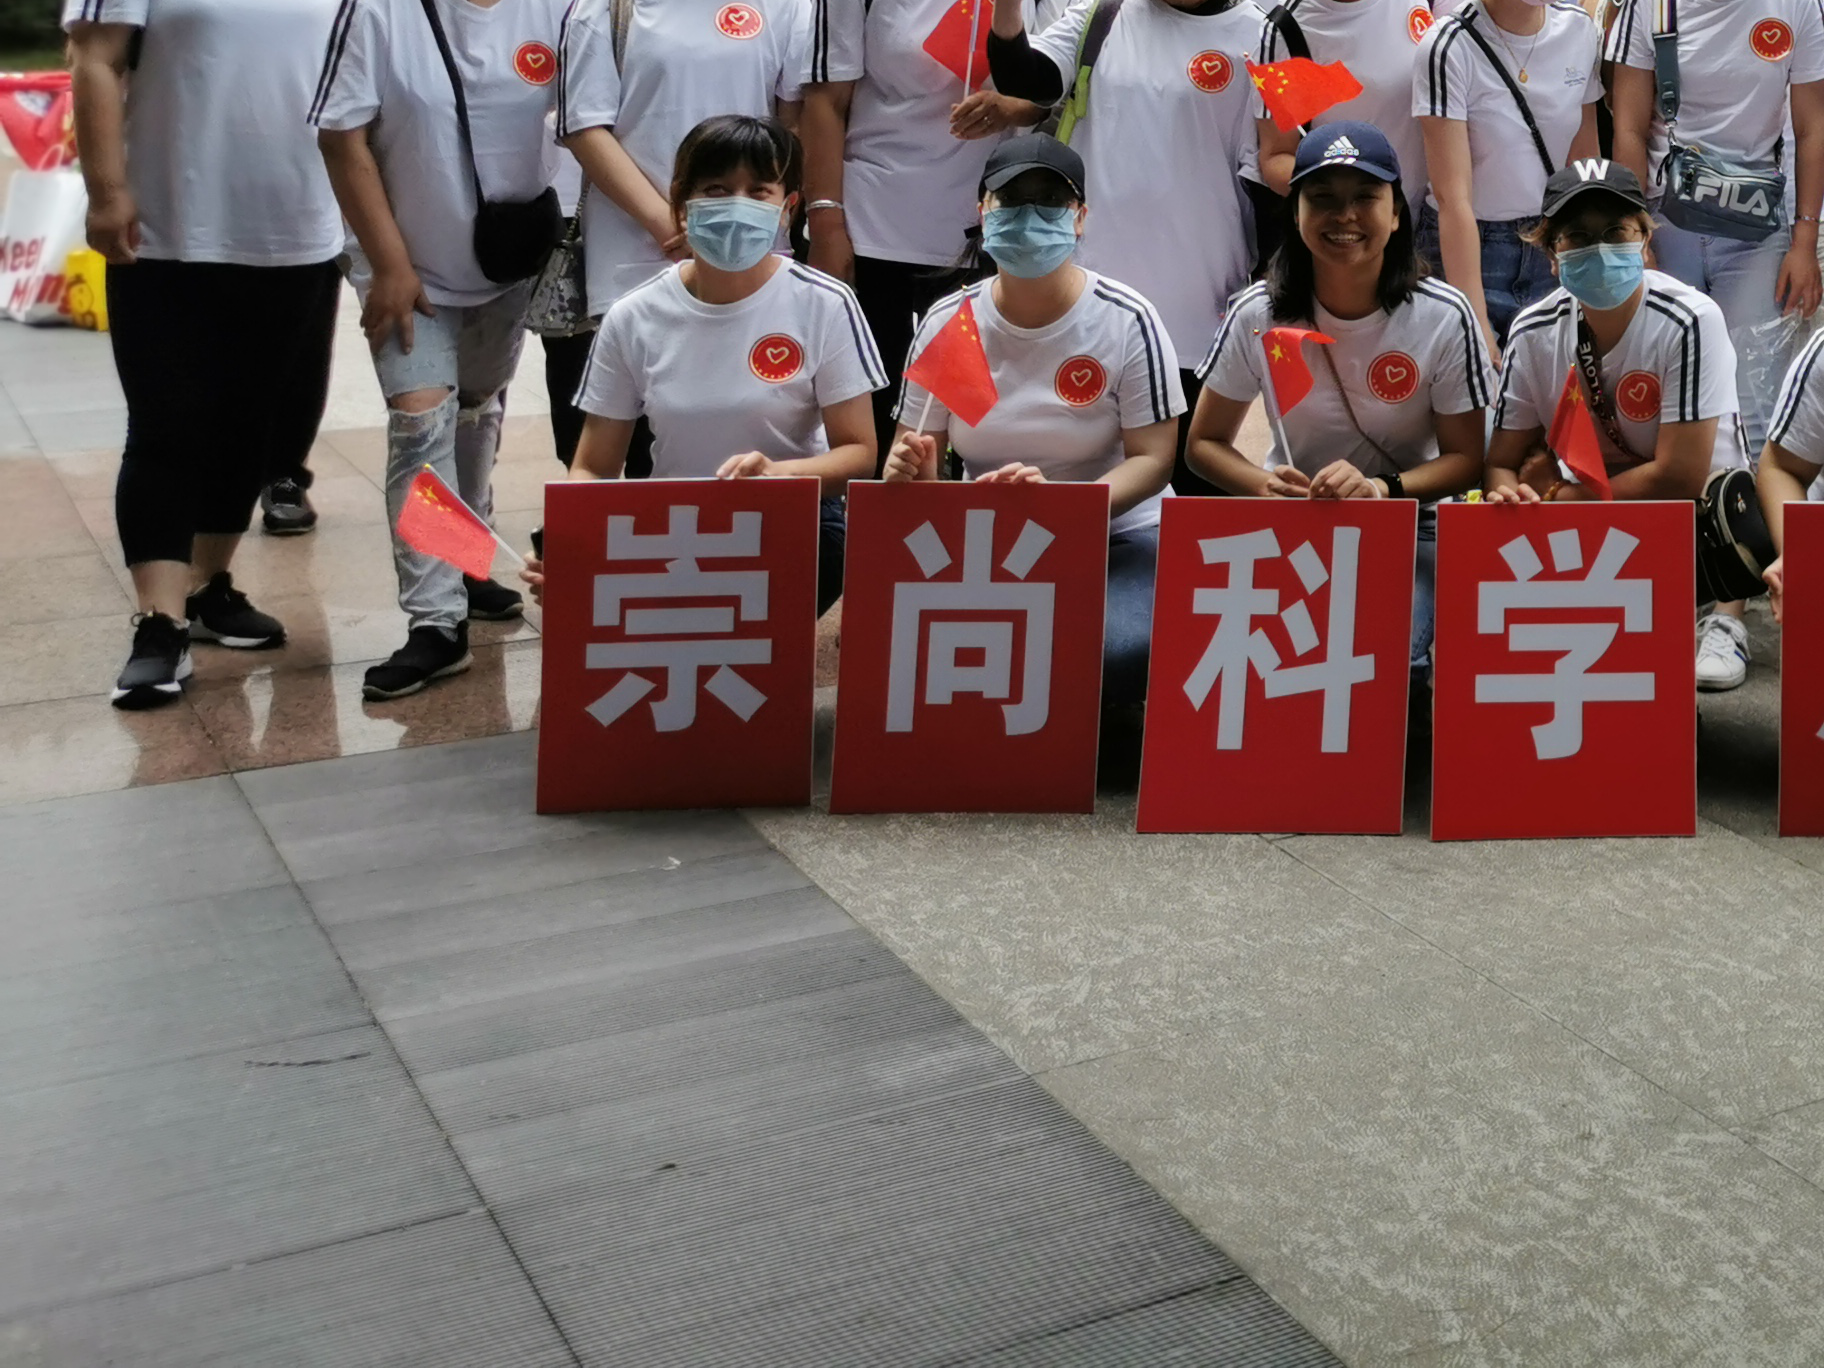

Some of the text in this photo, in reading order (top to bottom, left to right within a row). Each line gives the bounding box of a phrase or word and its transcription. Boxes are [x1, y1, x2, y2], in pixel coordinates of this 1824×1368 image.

[1573, 158, 1610, 182] W
[1694, 176, 1770, 217] FILA
[585, 505, 772, 733] 崇
[885, 509, 1056, 736] 尚
[1183, 526, 1376, 753] 科
[1474, 527, 1655, 760] 学
